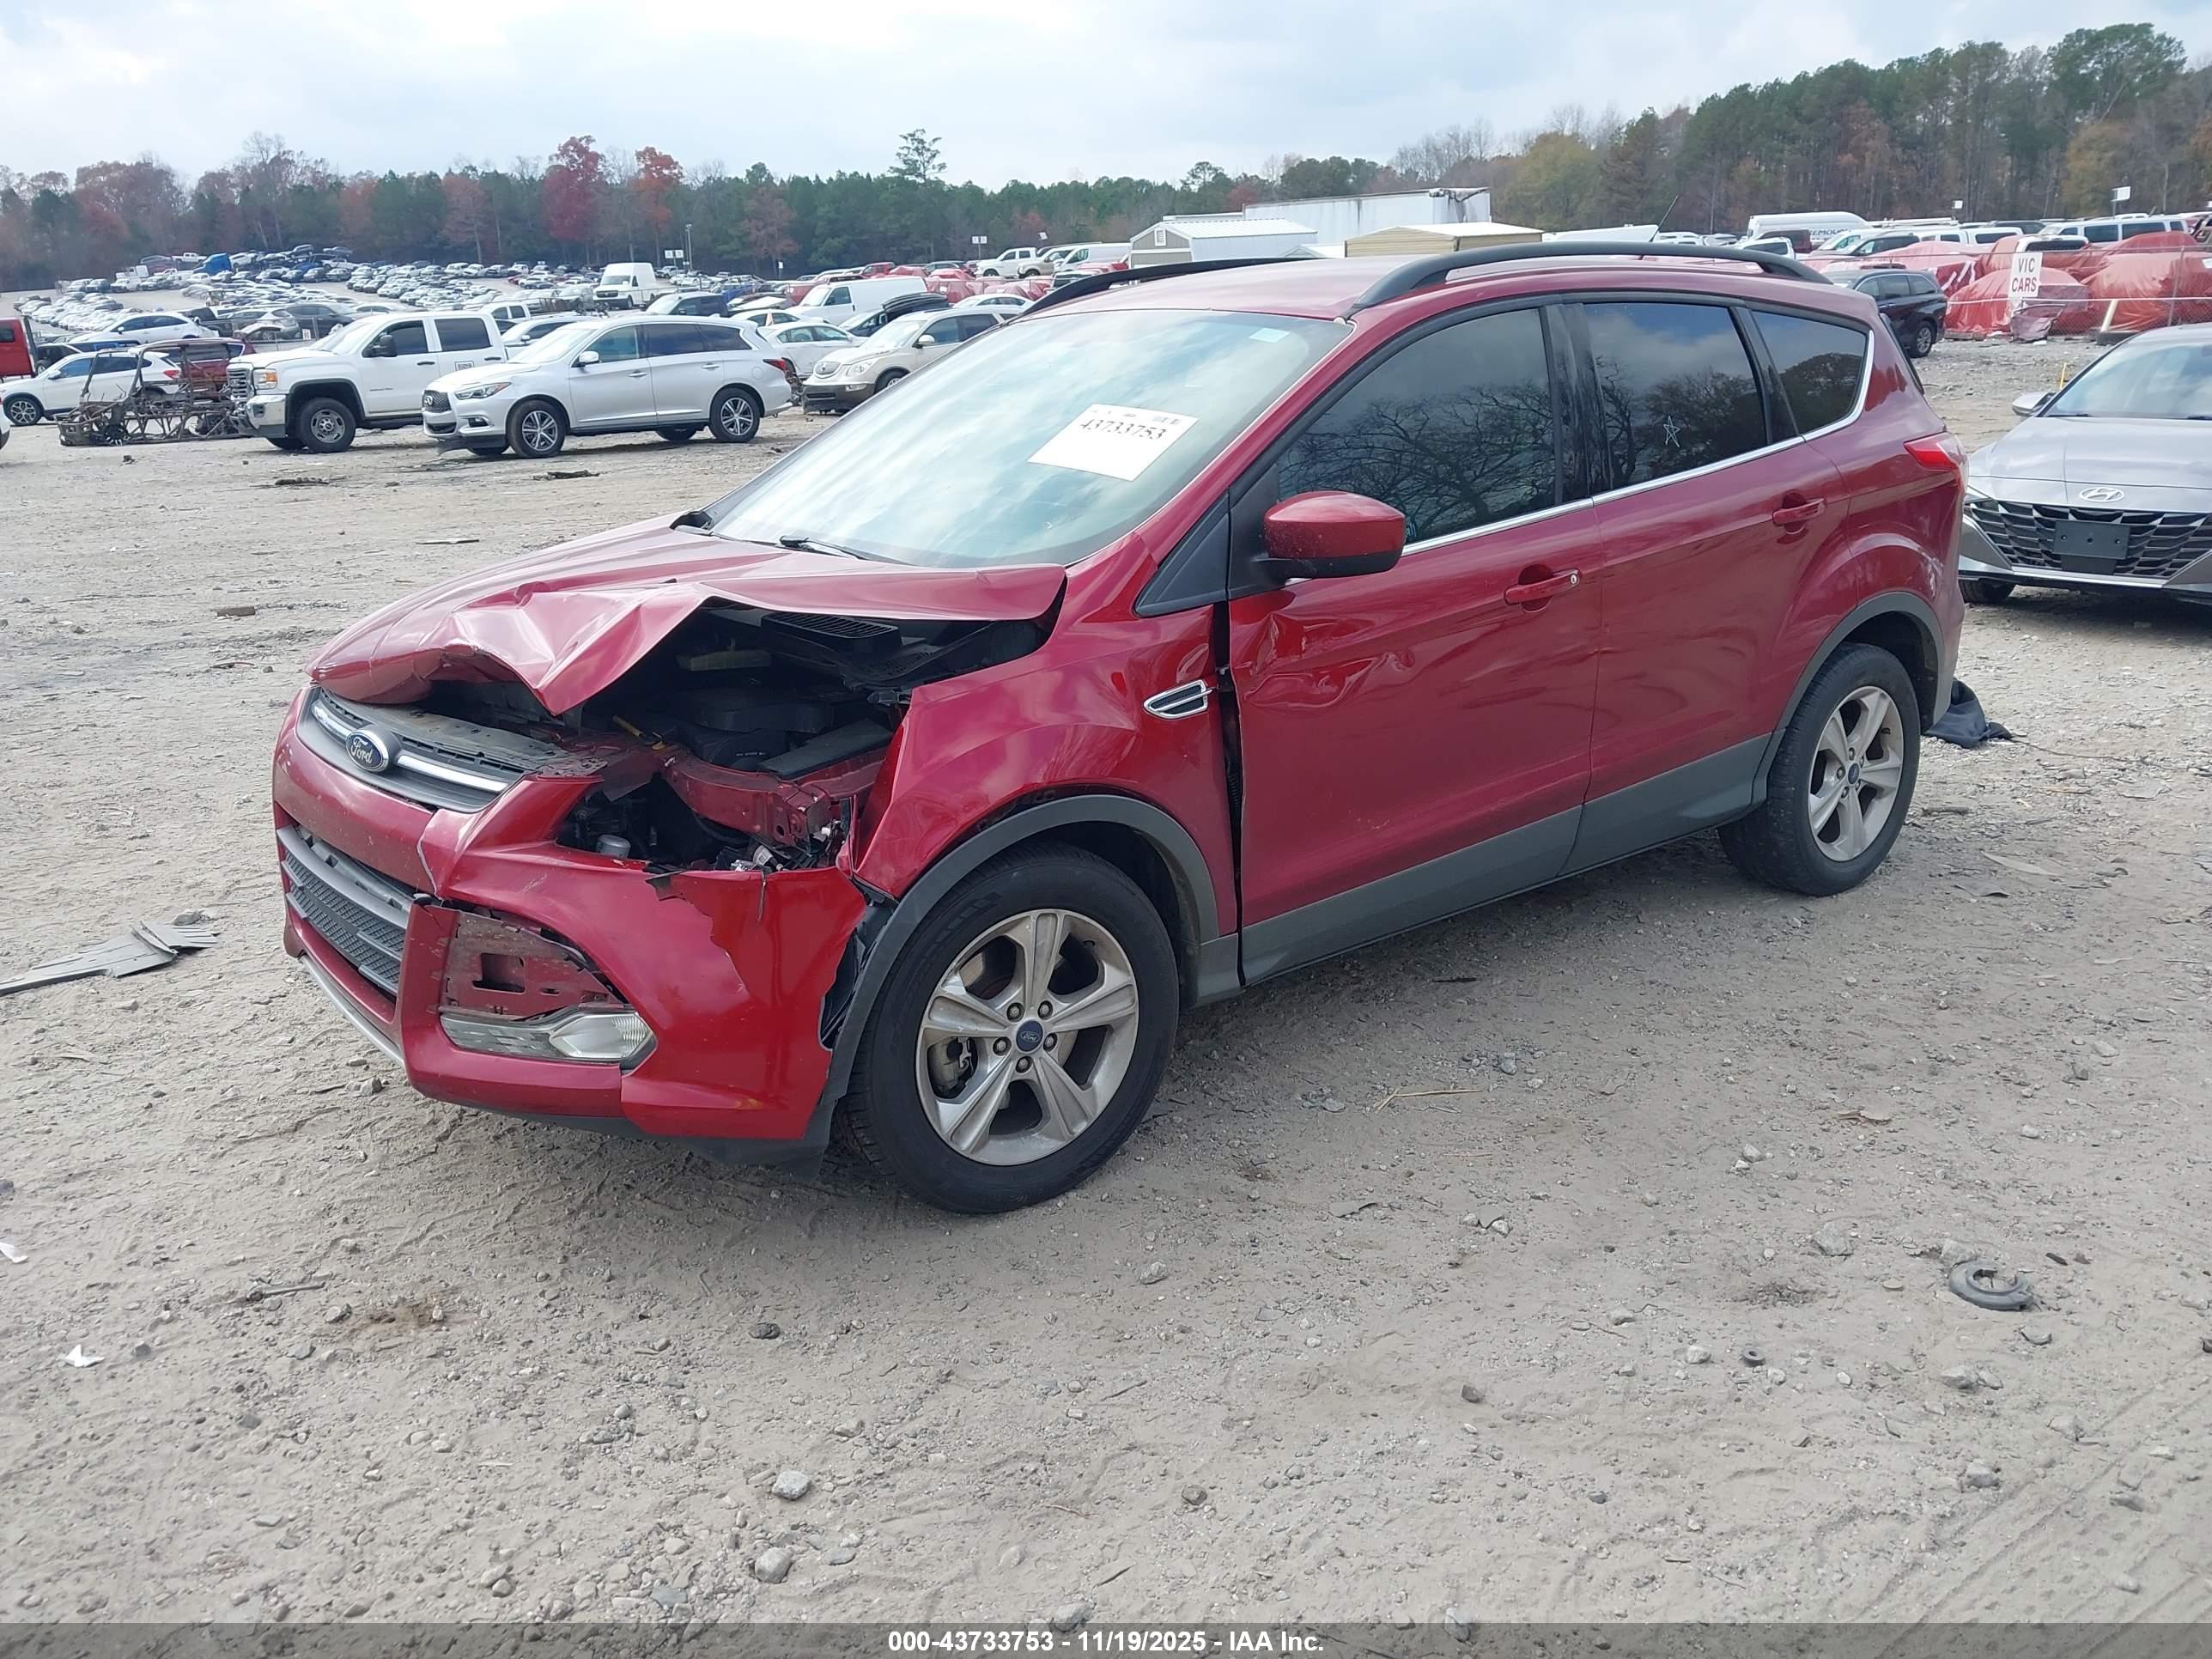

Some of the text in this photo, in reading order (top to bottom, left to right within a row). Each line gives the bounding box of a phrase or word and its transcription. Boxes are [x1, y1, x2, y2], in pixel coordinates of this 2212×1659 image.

[2018, 258, 2035, 273] VIC
[2011, 277, 2038, 293] CARS
[1080, 418, 1167, 440] 43733753
[350, 736, 373, 764] Ford
